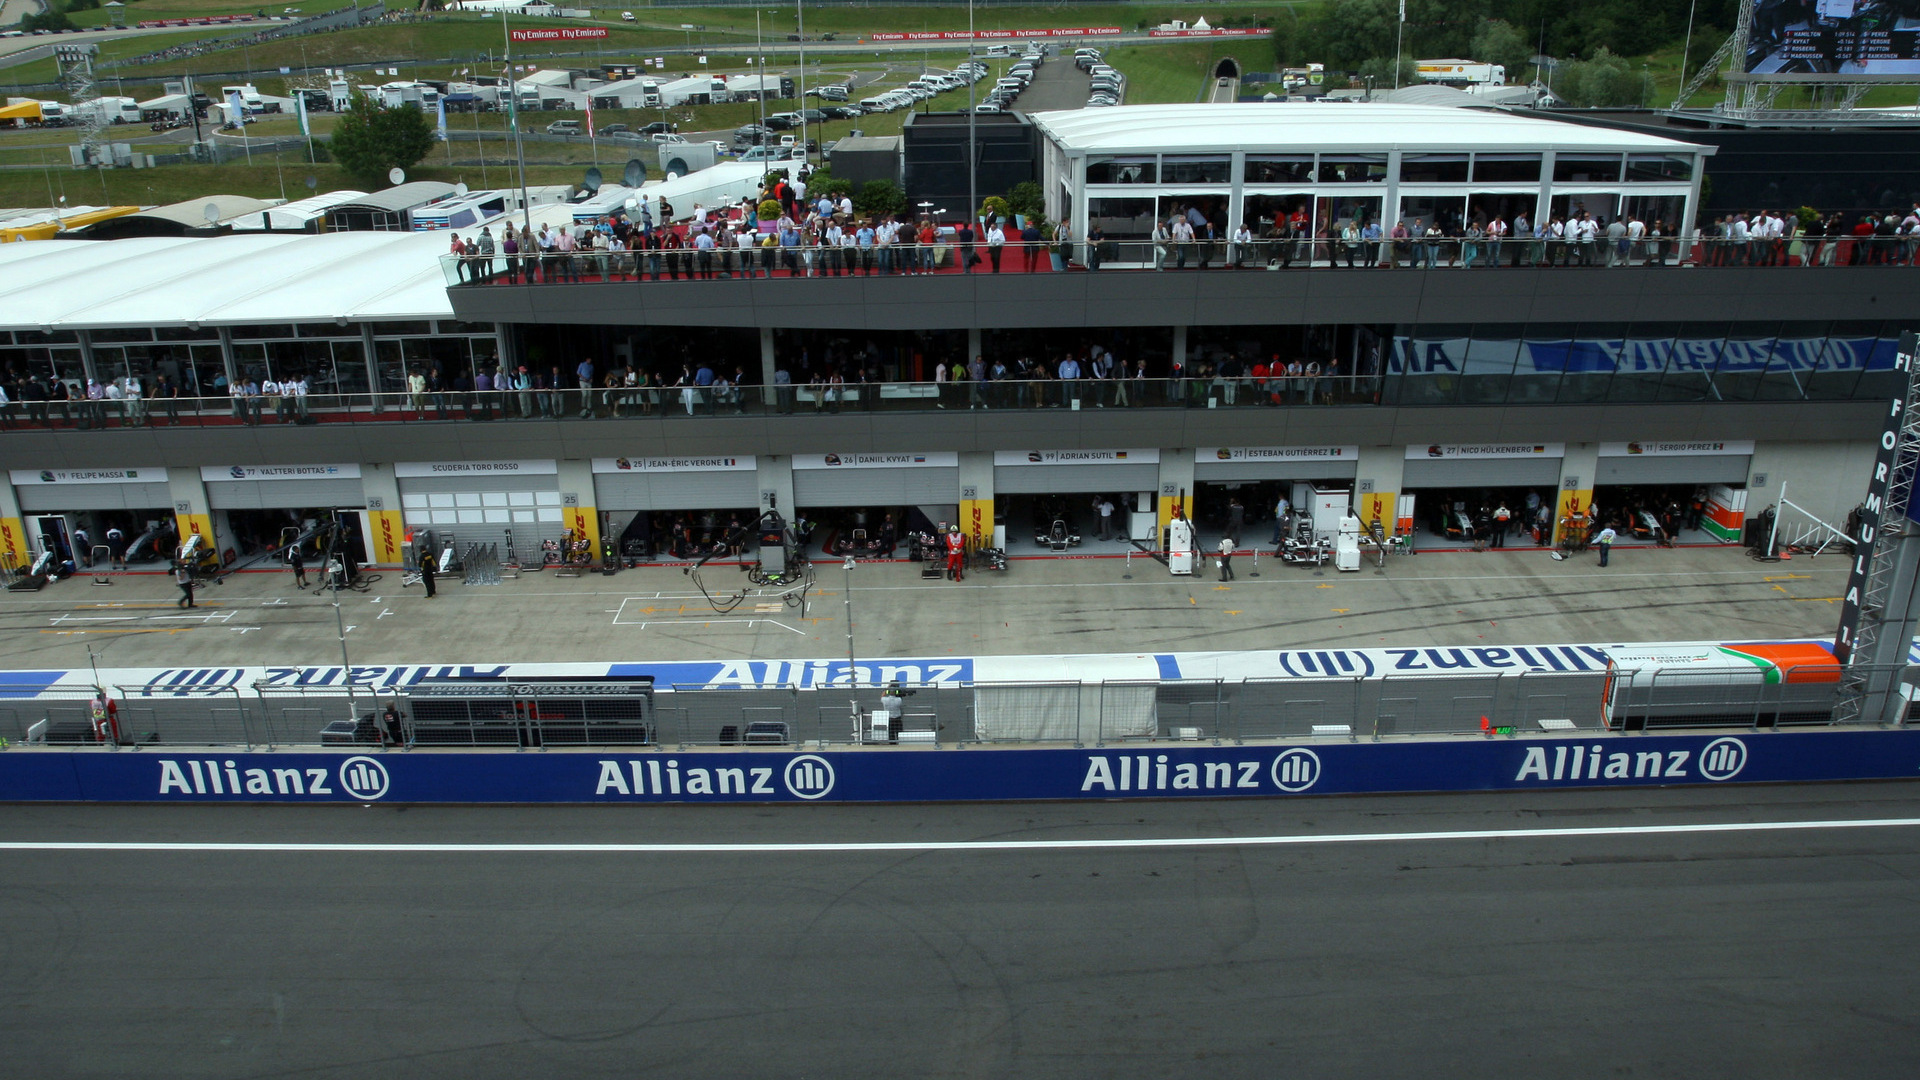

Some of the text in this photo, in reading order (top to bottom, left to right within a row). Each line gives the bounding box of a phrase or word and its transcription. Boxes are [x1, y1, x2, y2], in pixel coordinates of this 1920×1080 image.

[513, 30, 559, 40] Fly Emirates
[562, 28, 606, 38] Fly Emirates
[1234, 450, 1243, 458] 21
[1248, 449, 1284, 458] ESTEBAN
[1461, 446, 1478, 454] NICO
[1480, 445, 1532, 454] HÜLKENBERG
[844, 455, 910, 464] 26 DANIIL KVYAT
[1046, 452, 1114, 460] 99 ADRIAN SUTIL
[432, 463, 470, 472] SCUDERIA
[472, 463, 492, 471] TORO
[633, 460, 643, 468] 25
[689, 459, 722, 467] VERGNE
[71, 472, 97, 480] FELIPE
[98, 471, 125, 479] MASSA
[260, 467, 296, 475] VALTTERI
[1755, 476, 1764, 484] 19
[1362, 482, 1371, 490] 21
[763, 492, 775, 500] 2
[964, 488, 975, 497] 23
[370, 500, 380, 508] 26
[564, 496, 576, 504] 25
[1846, 399, 1902, 606] FORMULA
[380, 518, 394, 555] DHL
[702, 661, 962, 690] Allianz
[1515, 744, 1690, 781] Allianz
[159, 760, 332, 794] Allianz
[1081, 754, 1260, 791] Allianz
[596, 760, 775, 795] Allianz
